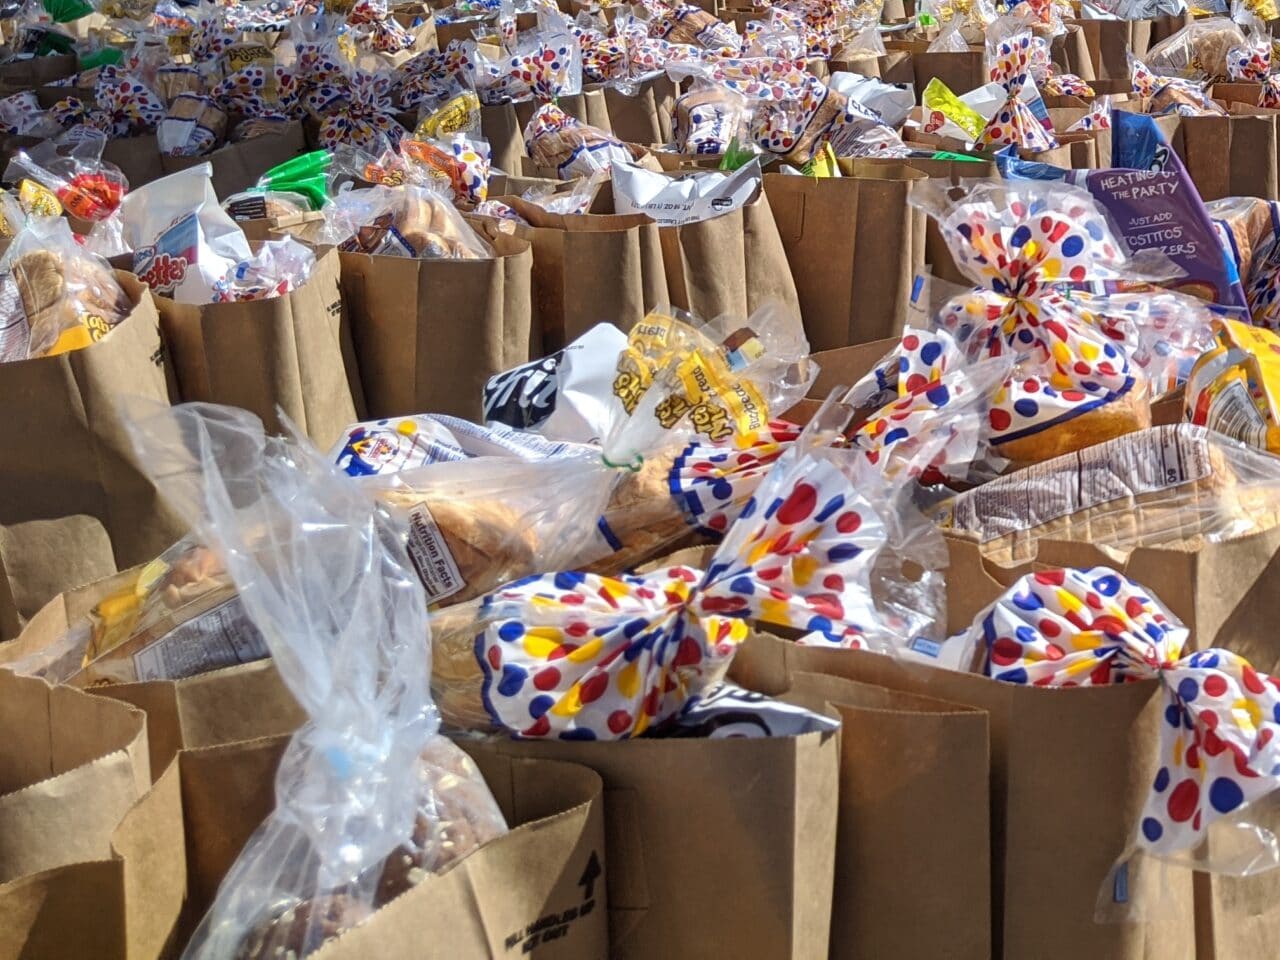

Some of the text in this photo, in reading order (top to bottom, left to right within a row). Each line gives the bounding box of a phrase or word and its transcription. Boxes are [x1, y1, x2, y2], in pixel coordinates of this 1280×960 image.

[1100, 170, 1156, 190] HEATING
[1112, 181, 1179, 200] THE PARTY
[1129, 212, 1172, 225] JUST ADD
[1124, 226, 1183, 246] TOSTITOS
[411, 511, 439, 559] Nutrition
[434, 560, 454, 588] Facts
